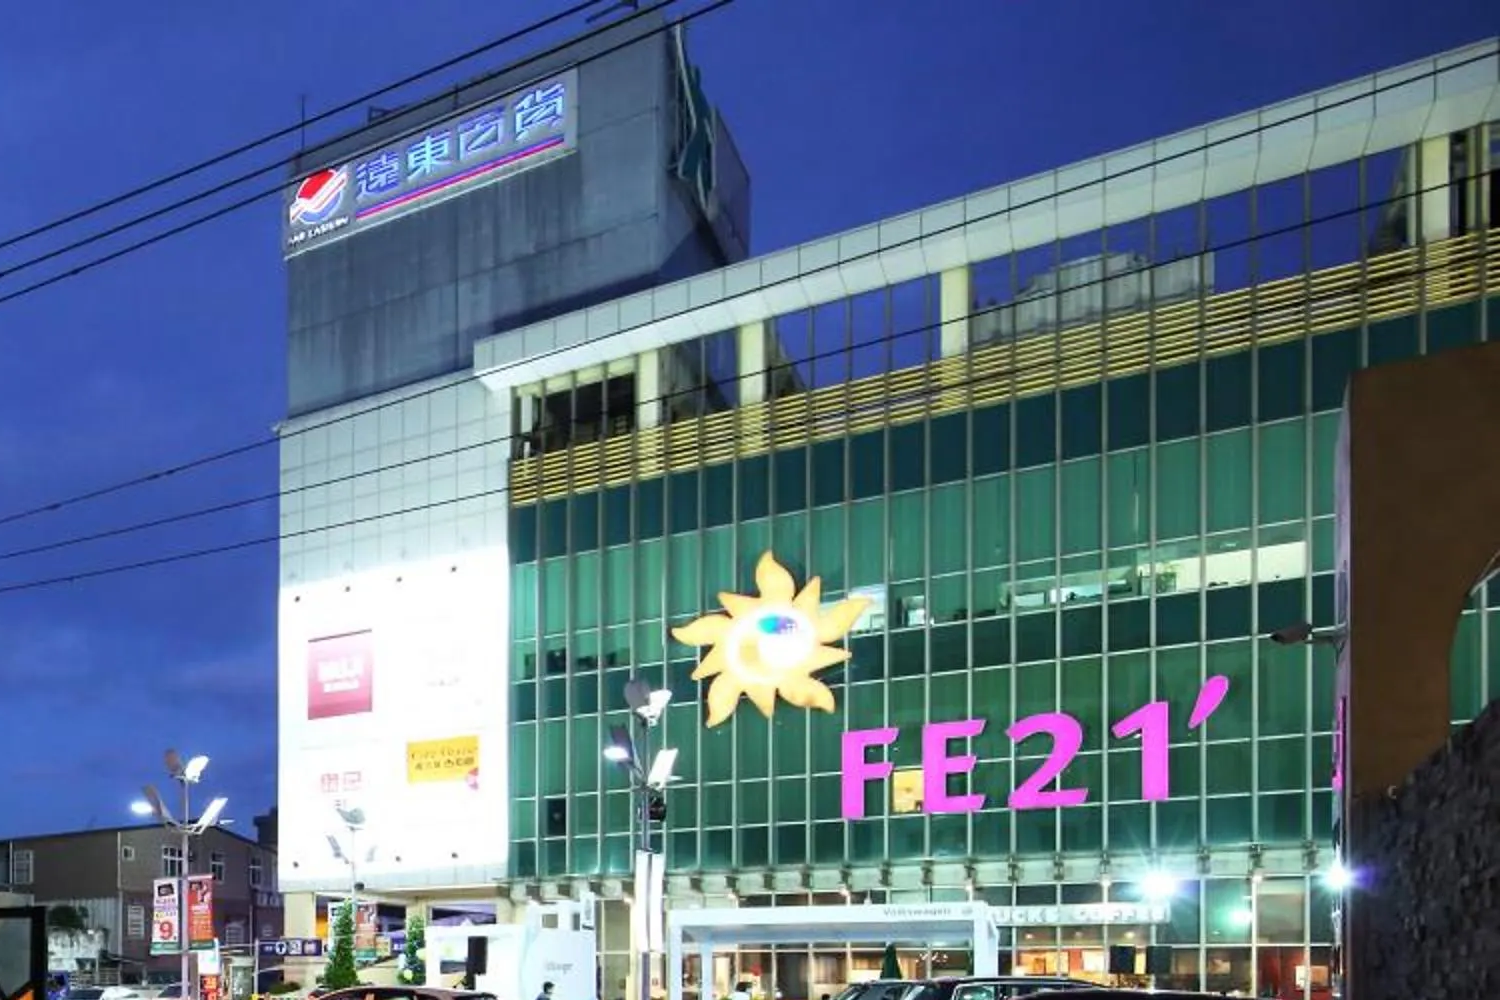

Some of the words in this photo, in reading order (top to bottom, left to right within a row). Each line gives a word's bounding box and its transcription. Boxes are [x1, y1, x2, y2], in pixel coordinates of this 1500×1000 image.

[356, 83, 565, 200] 遠東百貨
[160, 921, 174, 940] 9
